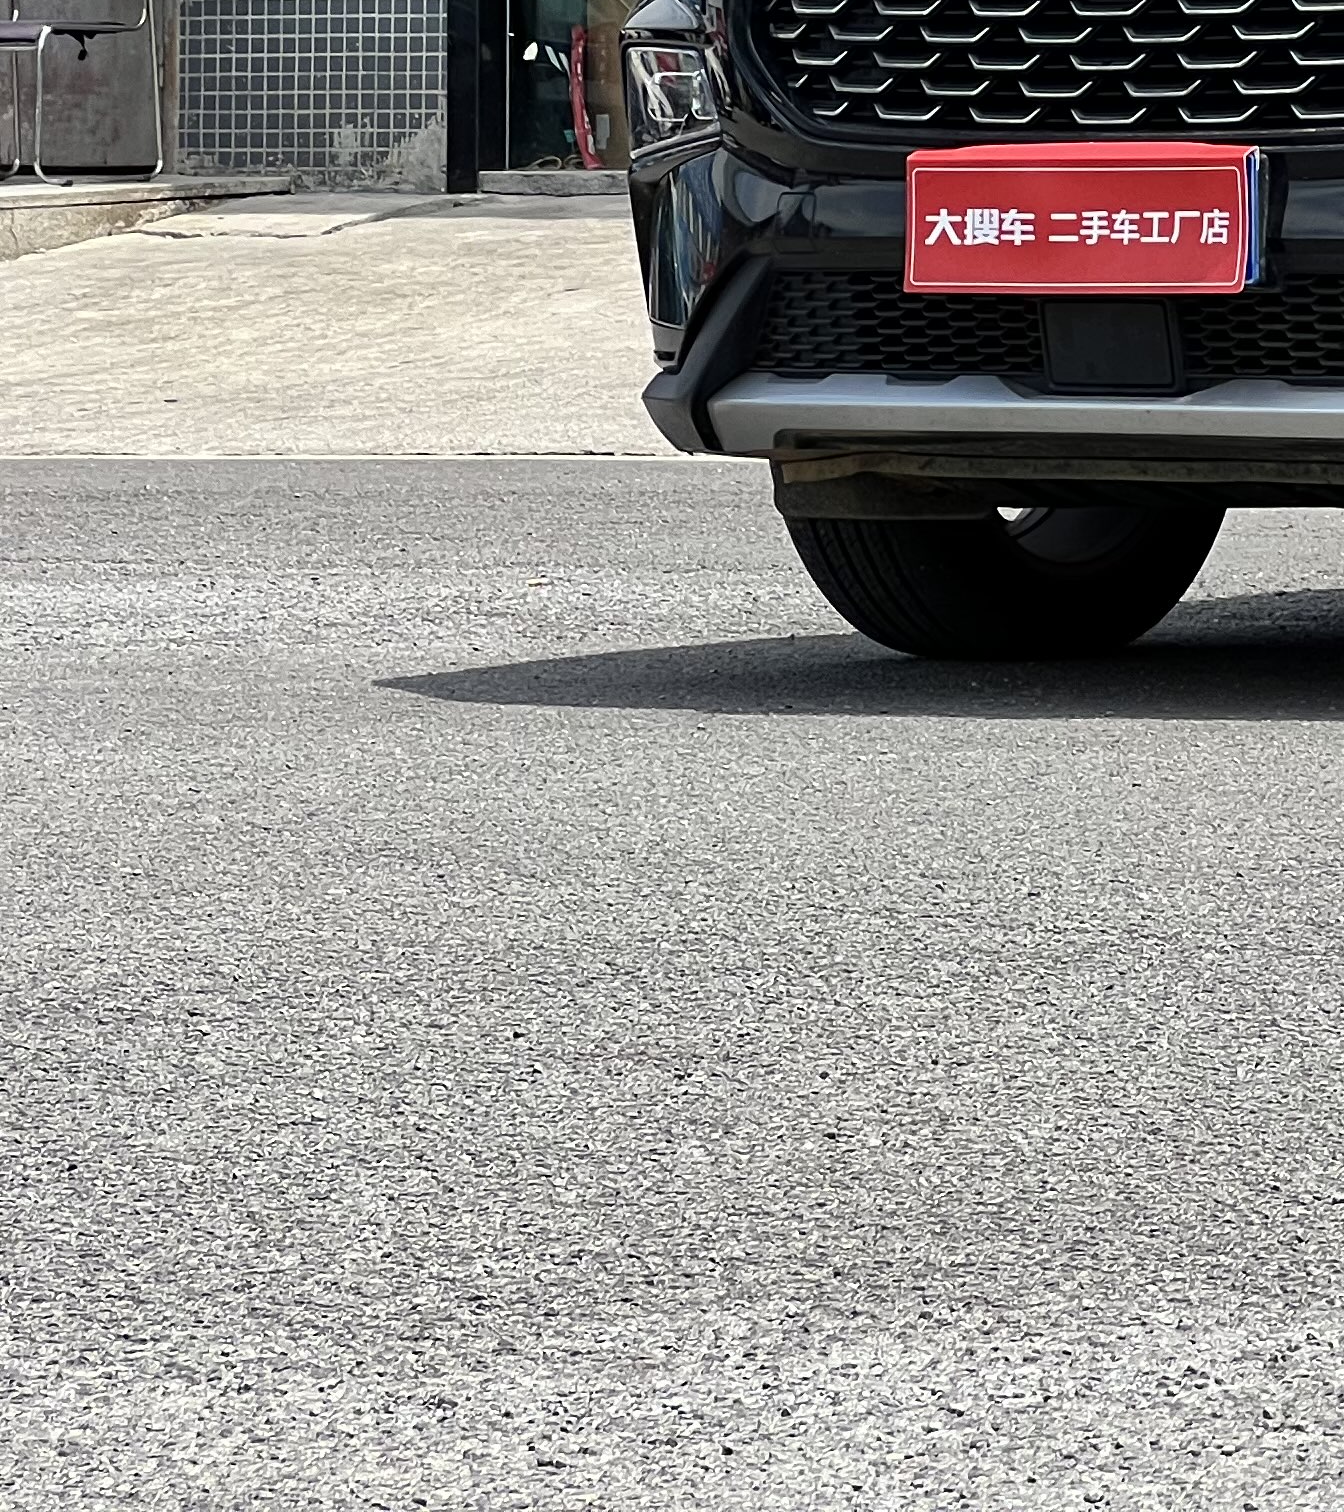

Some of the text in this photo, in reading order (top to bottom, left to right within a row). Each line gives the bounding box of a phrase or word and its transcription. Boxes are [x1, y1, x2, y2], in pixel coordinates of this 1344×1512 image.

[925, 208, 1231, 246] 大搜车 二手车工厂店
